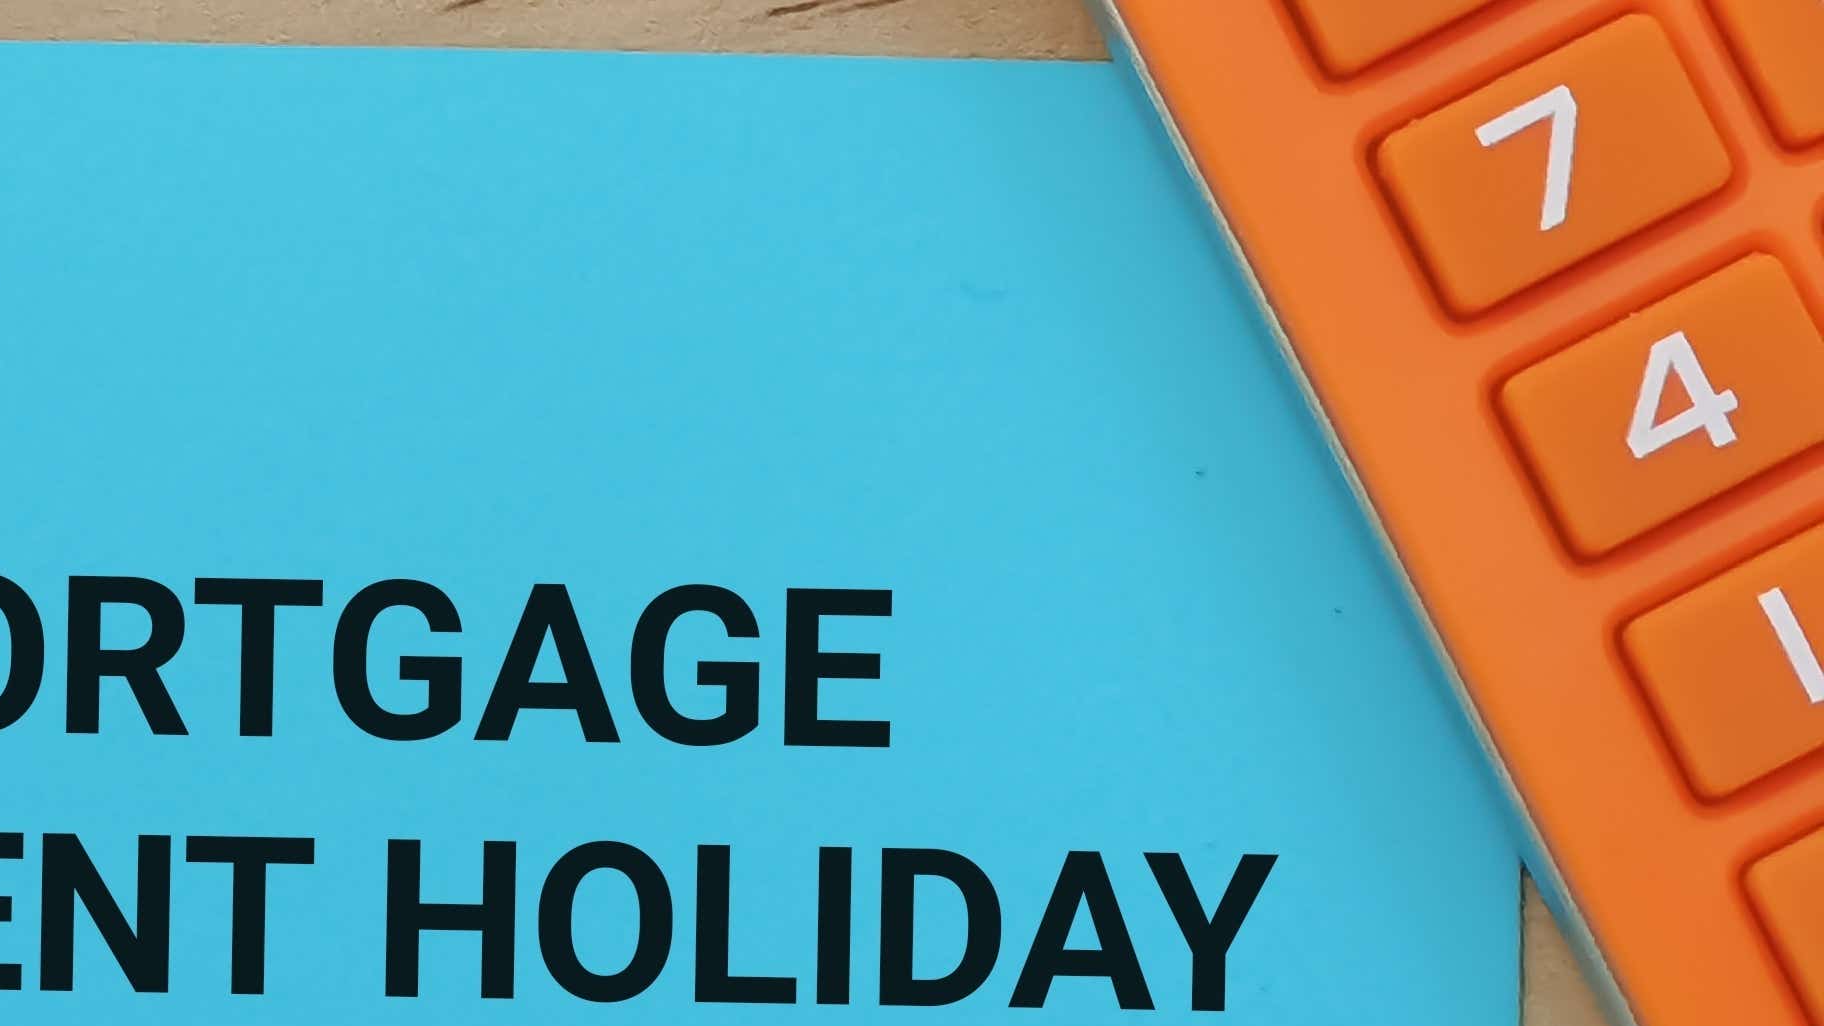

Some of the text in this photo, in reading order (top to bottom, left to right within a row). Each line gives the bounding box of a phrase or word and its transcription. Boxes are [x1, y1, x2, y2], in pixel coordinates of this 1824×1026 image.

[1474, 84, 1577, 231] 7
[1625, 331, 1738, 459] 4
[386, 839, 1279, 1012] HOLIDAY
